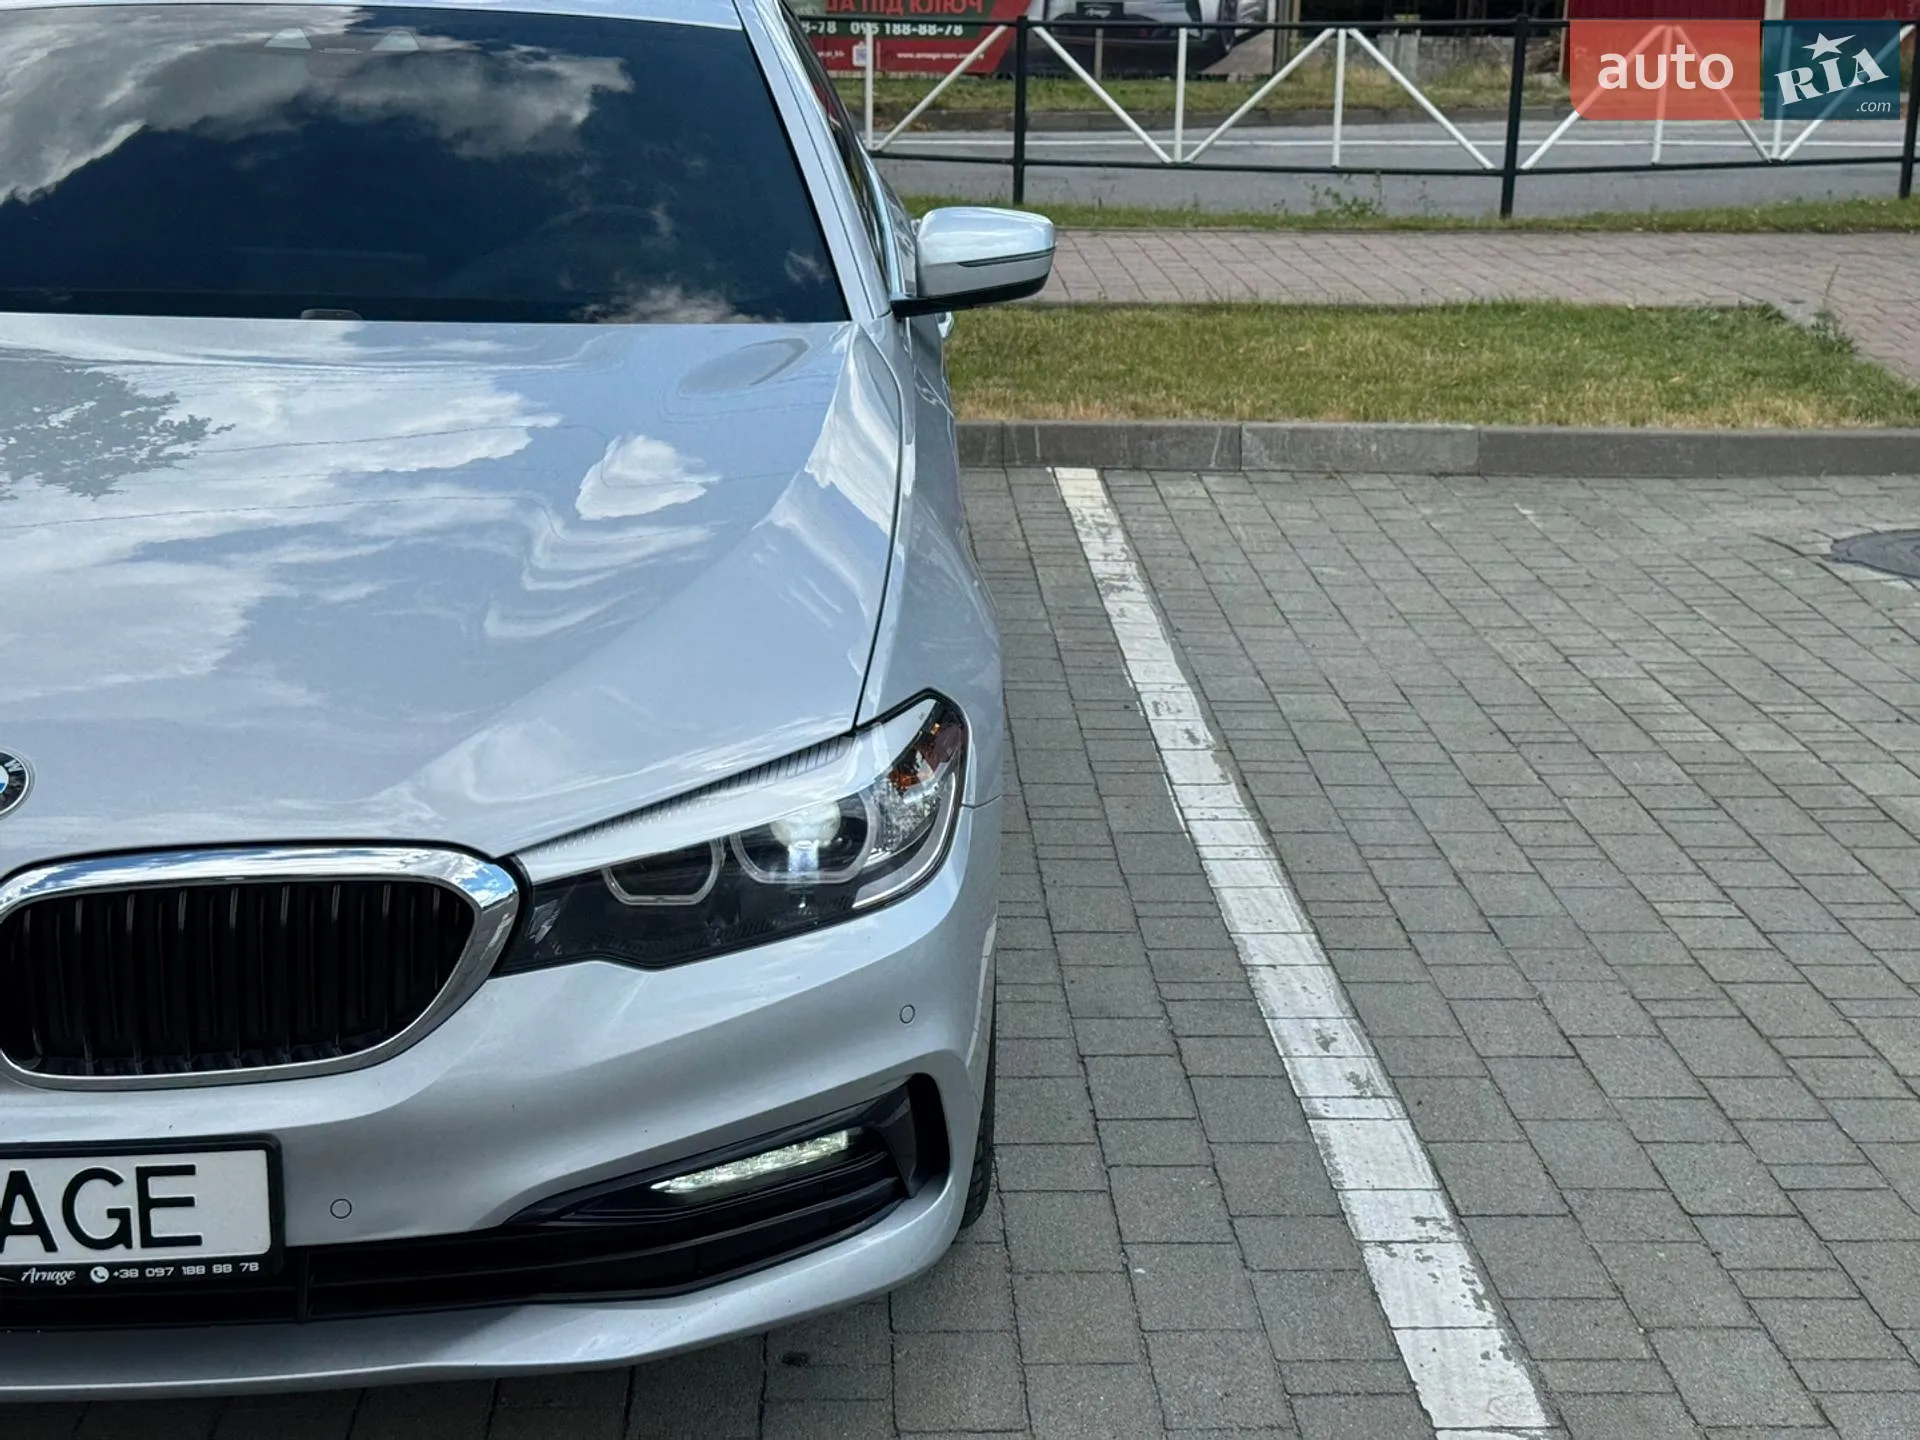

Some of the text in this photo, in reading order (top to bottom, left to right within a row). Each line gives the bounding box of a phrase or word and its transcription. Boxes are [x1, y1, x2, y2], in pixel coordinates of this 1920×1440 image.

[0, 1165, 203, 1252] AGE
[20, 1262, 260, 1285] Arnage +38 097 188 88 78
